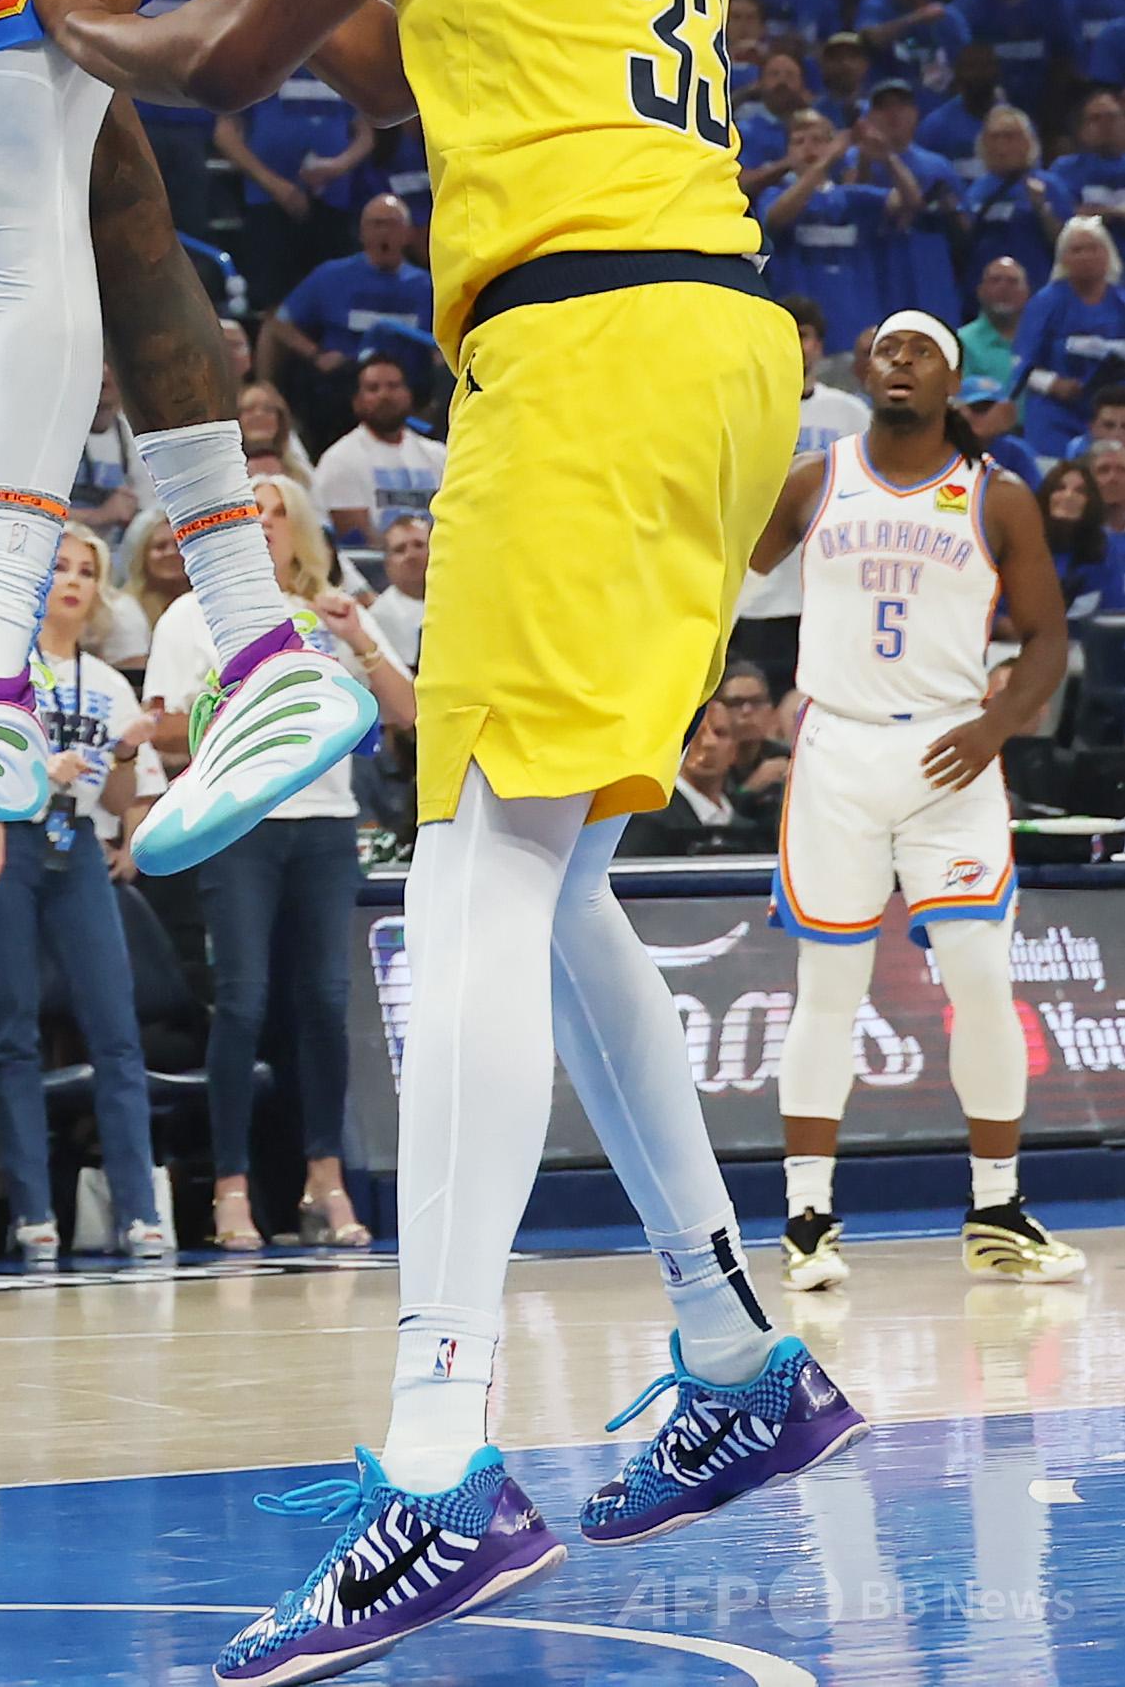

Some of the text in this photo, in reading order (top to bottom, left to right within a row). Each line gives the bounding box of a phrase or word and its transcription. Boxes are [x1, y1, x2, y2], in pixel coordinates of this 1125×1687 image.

[819, 520, 973, 571] OKLAHOMA
[860, 559, 924, 595] CITY
[874, 597, 908, 663] 5
